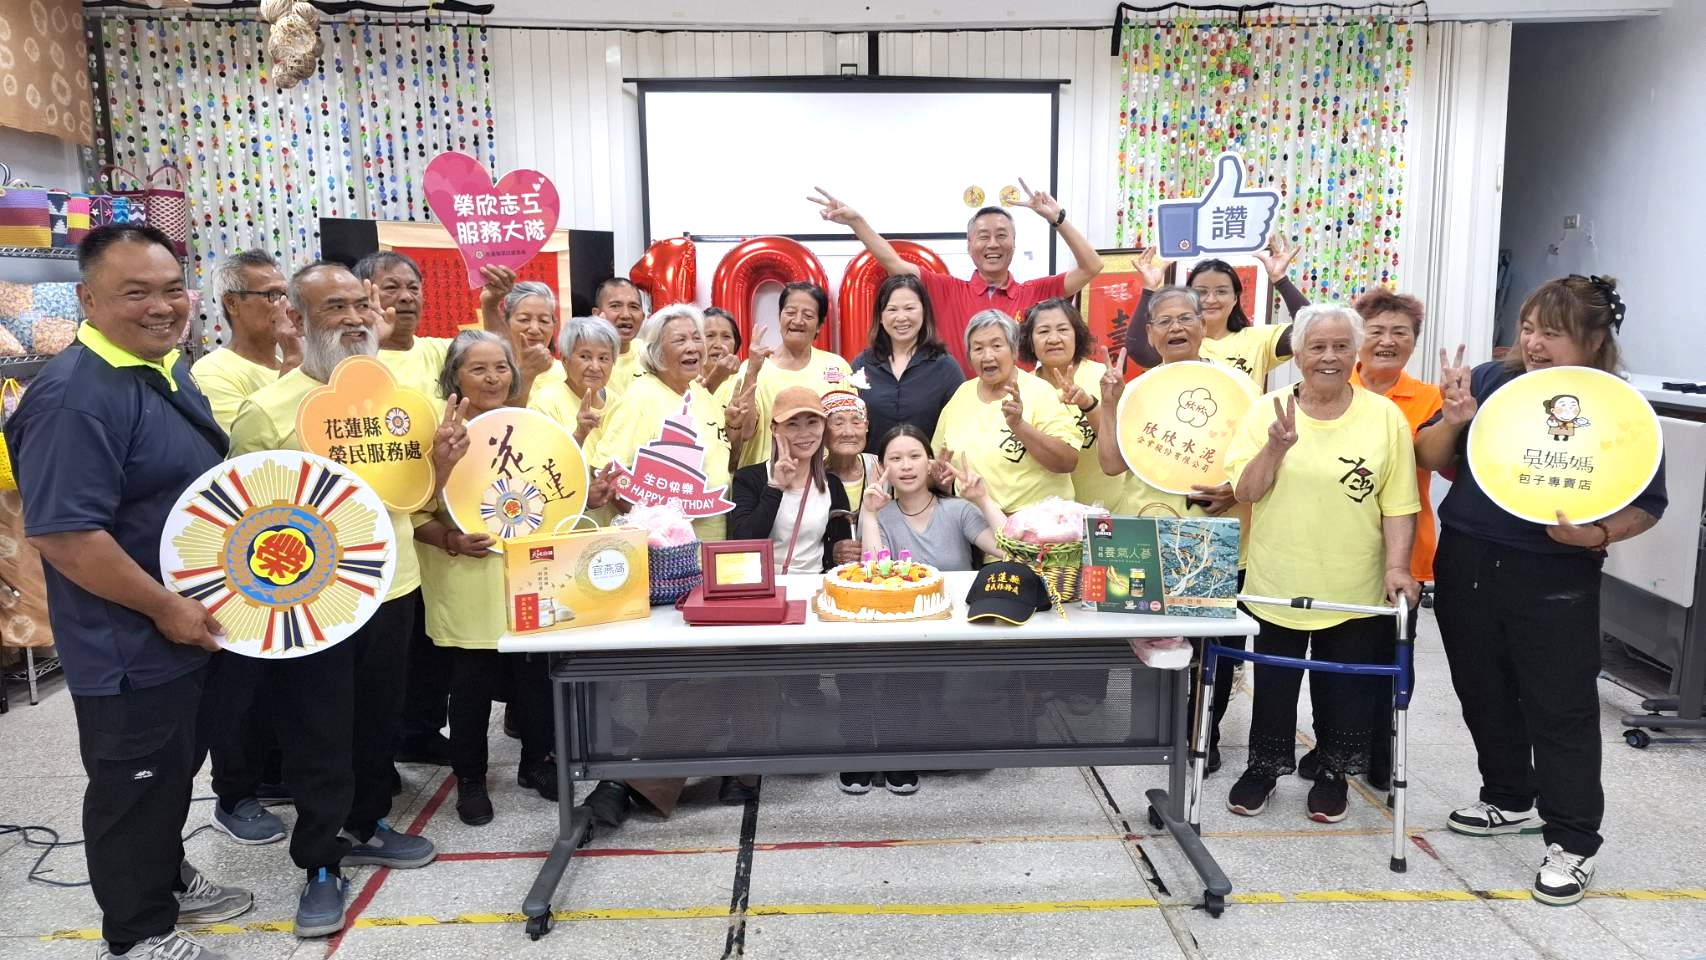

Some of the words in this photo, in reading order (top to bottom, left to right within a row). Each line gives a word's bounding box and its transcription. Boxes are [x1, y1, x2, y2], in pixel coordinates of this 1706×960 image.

[453, 193, 542, 217] 榮欣志工
[456, 219, 546, 244] 服務大隊
[1211, 205, 1248, 240] 讚
[1185, 400, 1207, 416] 欣欣
[323, 416, 383, 440] 花蓮縣
[328, 440, 422, 465] 榮民服務處
[1143, 422, 1216, 464] 欣欣水泥
[1523, 448, 1594, 474] 吳媽媽
[643, 472, 694, 495] 生日快樂
[1519, 473, 1593, 491] 包子專賣店
[631, 484, 665, 505] HAPPY
[667, 497, 715, 510] BTHDAY
[1104, 546, 1152, 560] 養氣人蔘
